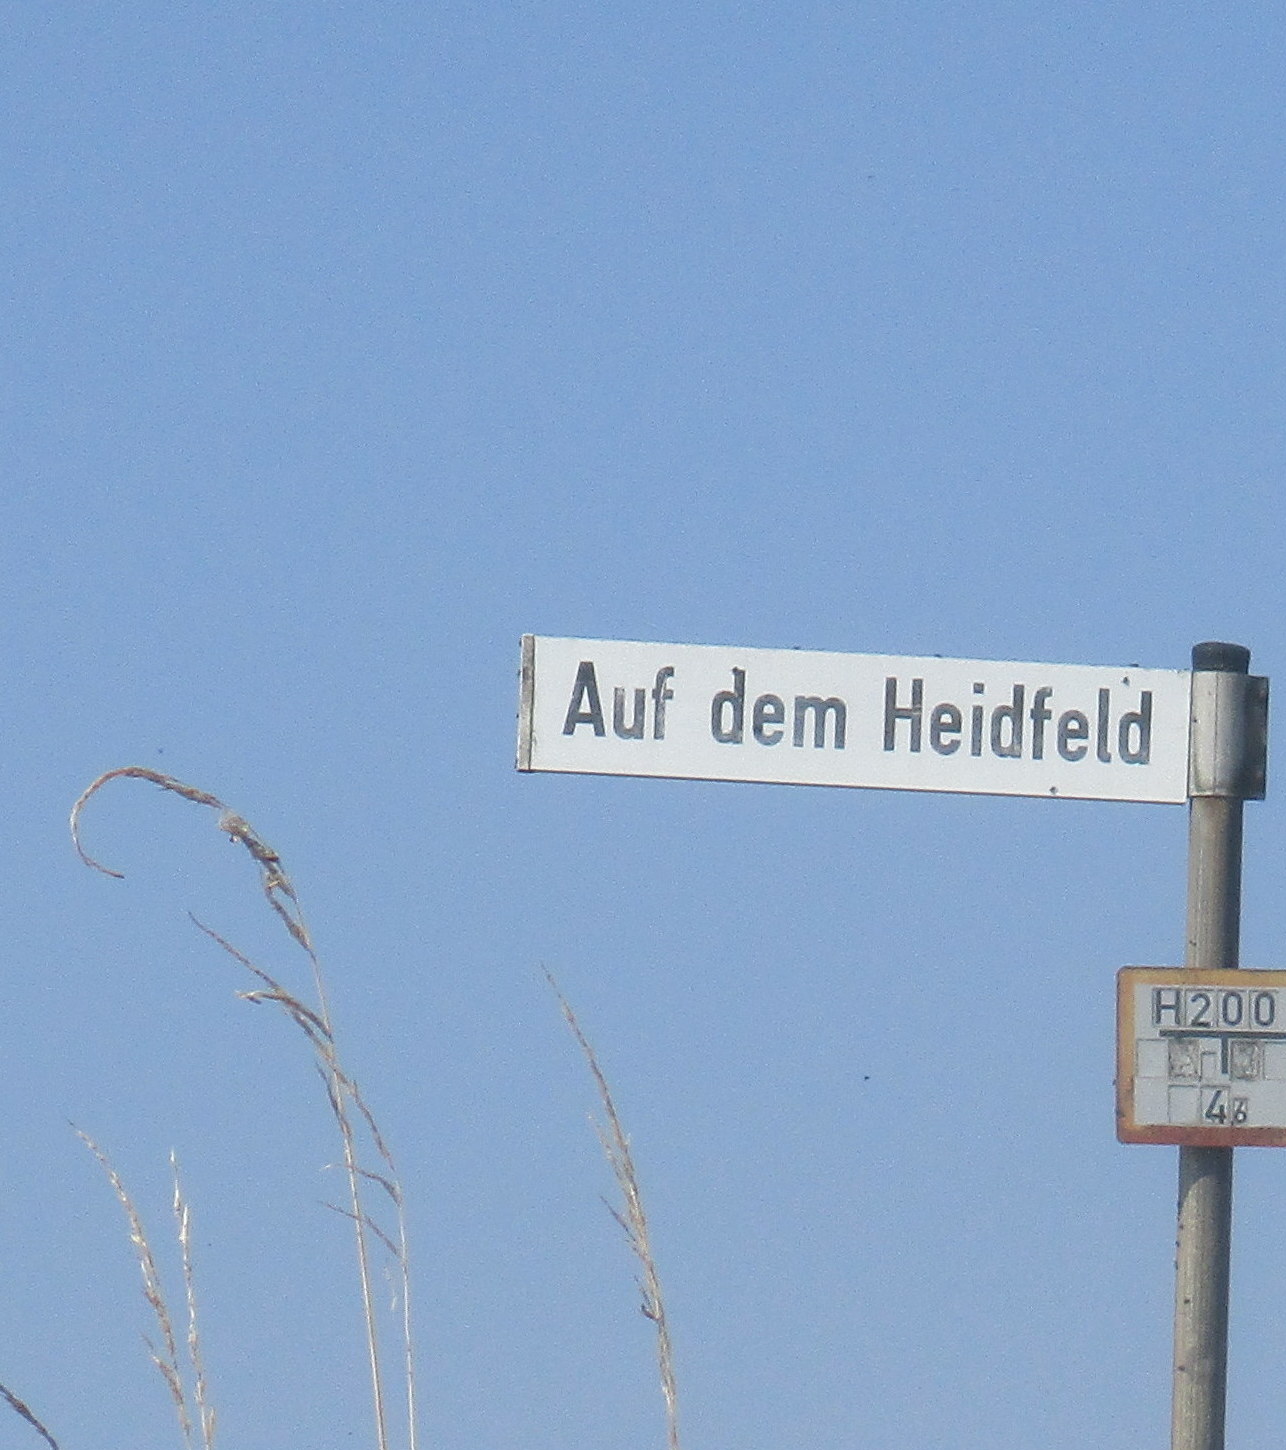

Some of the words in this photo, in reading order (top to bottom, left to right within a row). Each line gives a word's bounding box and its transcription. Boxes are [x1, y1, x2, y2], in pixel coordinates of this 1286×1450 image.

[562, 660, 675, 740] Auf
[711, 666, 847, 749] dem
[883, 676, 1153, 765] Heidfeld
[1154, 988, 1276, 1028] H200
